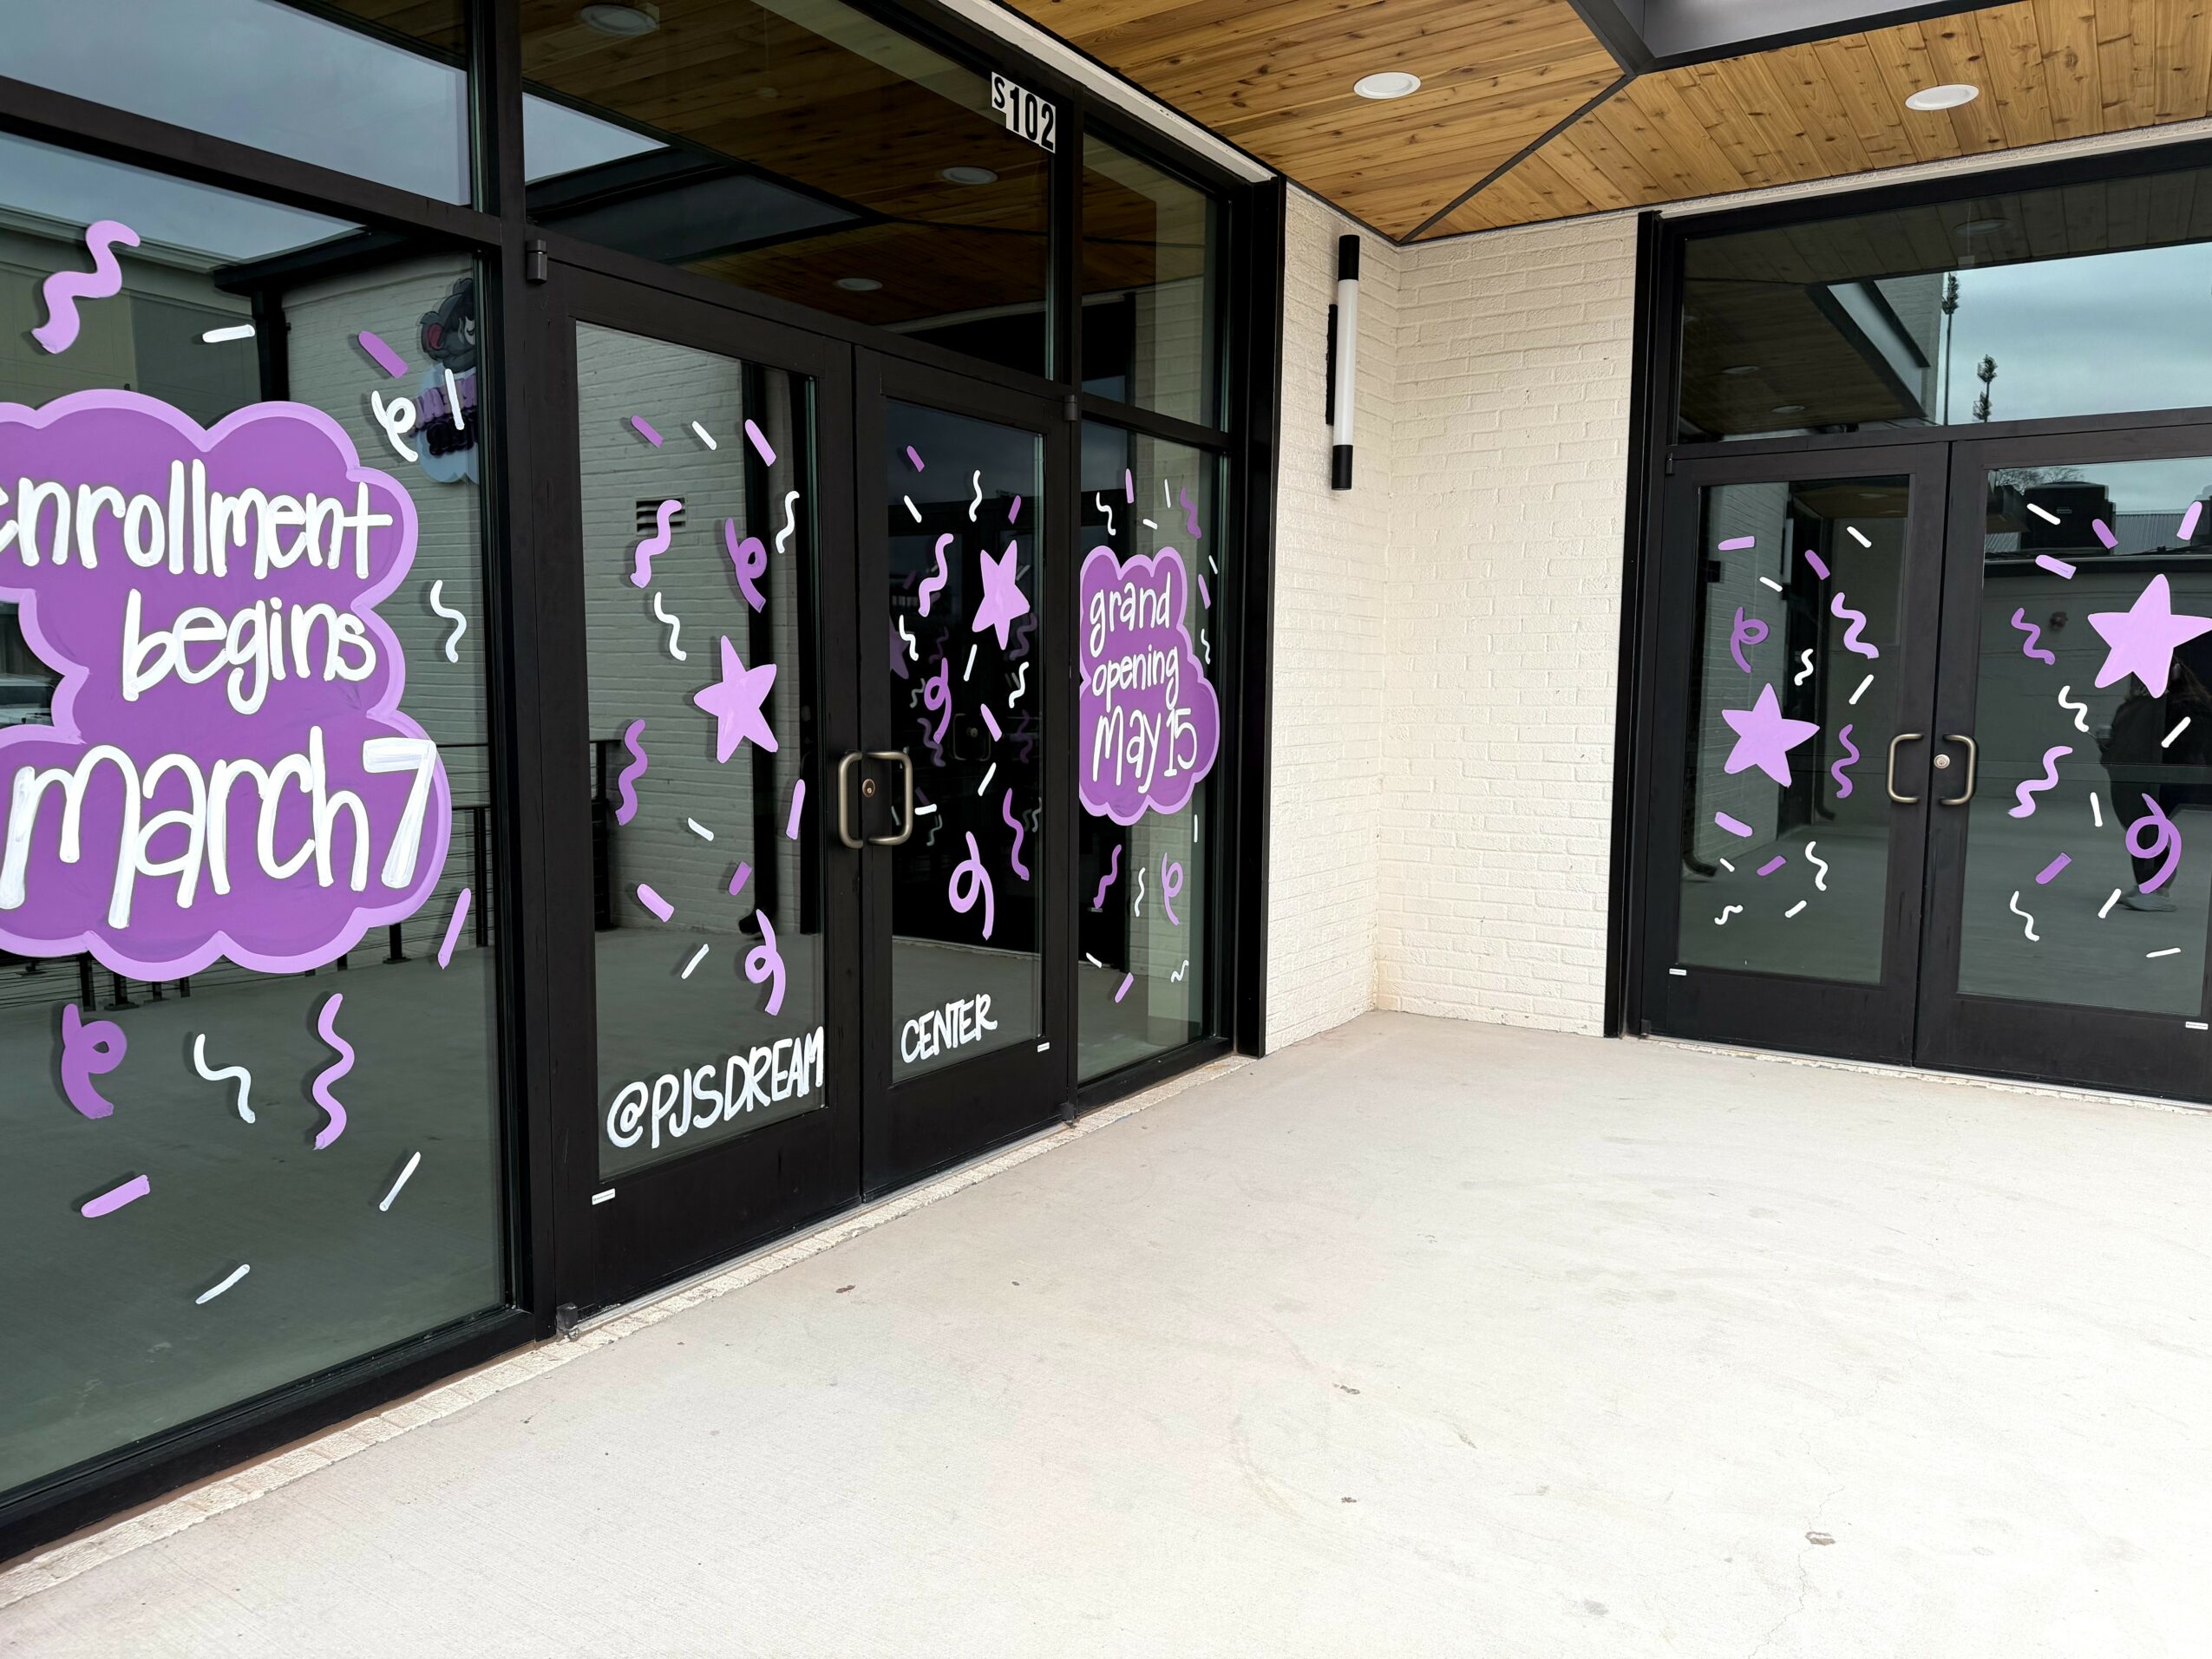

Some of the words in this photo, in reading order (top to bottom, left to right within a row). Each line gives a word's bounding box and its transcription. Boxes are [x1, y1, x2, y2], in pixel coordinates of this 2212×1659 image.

[122, 588, 377, 715] begins
[1089, 571, 1171, 658] grand
[1091, 643, 1180, 711] opening
[1163, 707, 1198, 778] 15
[362, 737, 436, 890] 7
[606, 1026, 824, 1150] @PJSDREAM
[900, 993, 998, 1063] CENTER
